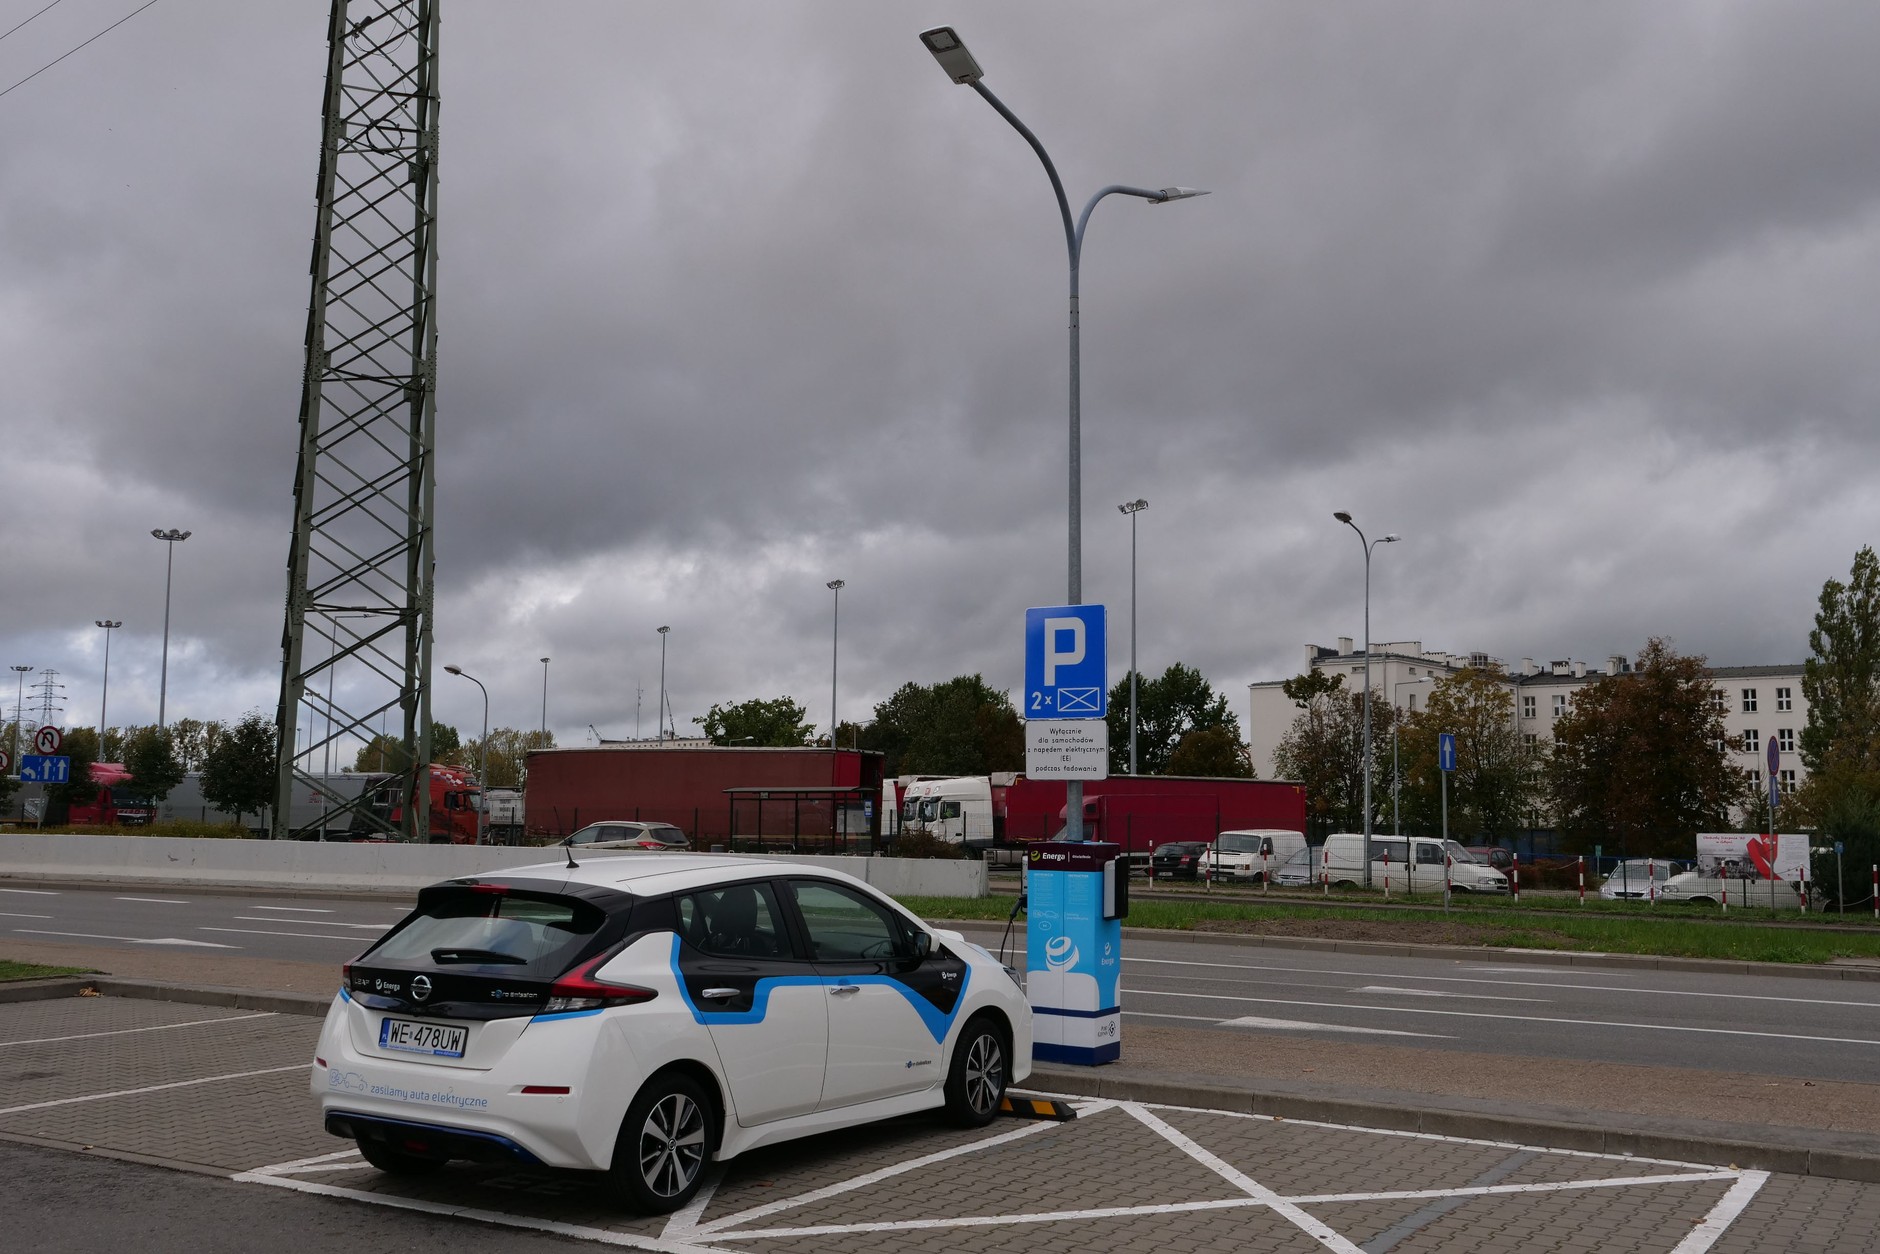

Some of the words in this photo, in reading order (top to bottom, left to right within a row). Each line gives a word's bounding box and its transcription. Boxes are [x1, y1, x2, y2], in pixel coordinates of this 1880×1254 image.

[1043, 616, 1086, 687] P
[1031, 691, 1042, 710] 2
[1044, 695, 1052, 705] x
[1049, 728, 1082, 736] Wyłącznie
[1065, 746, 1105, 754] elektrycznym
[1035, 765, 1061, 773] podczas
[1042, 852, 1066, 862] Energa
[1101, 957, 1115, 966] Energa
[383, 982, 401, 992] Energa
[390, 1022, 410, 1044] WE
[414, 1026, 462, 1052] 478UW
[370, 1084, 408, 1101] zasilamy
[409, 1090, 430, 1102] auta
[431, 1091, 488, 1108] elektryczne
